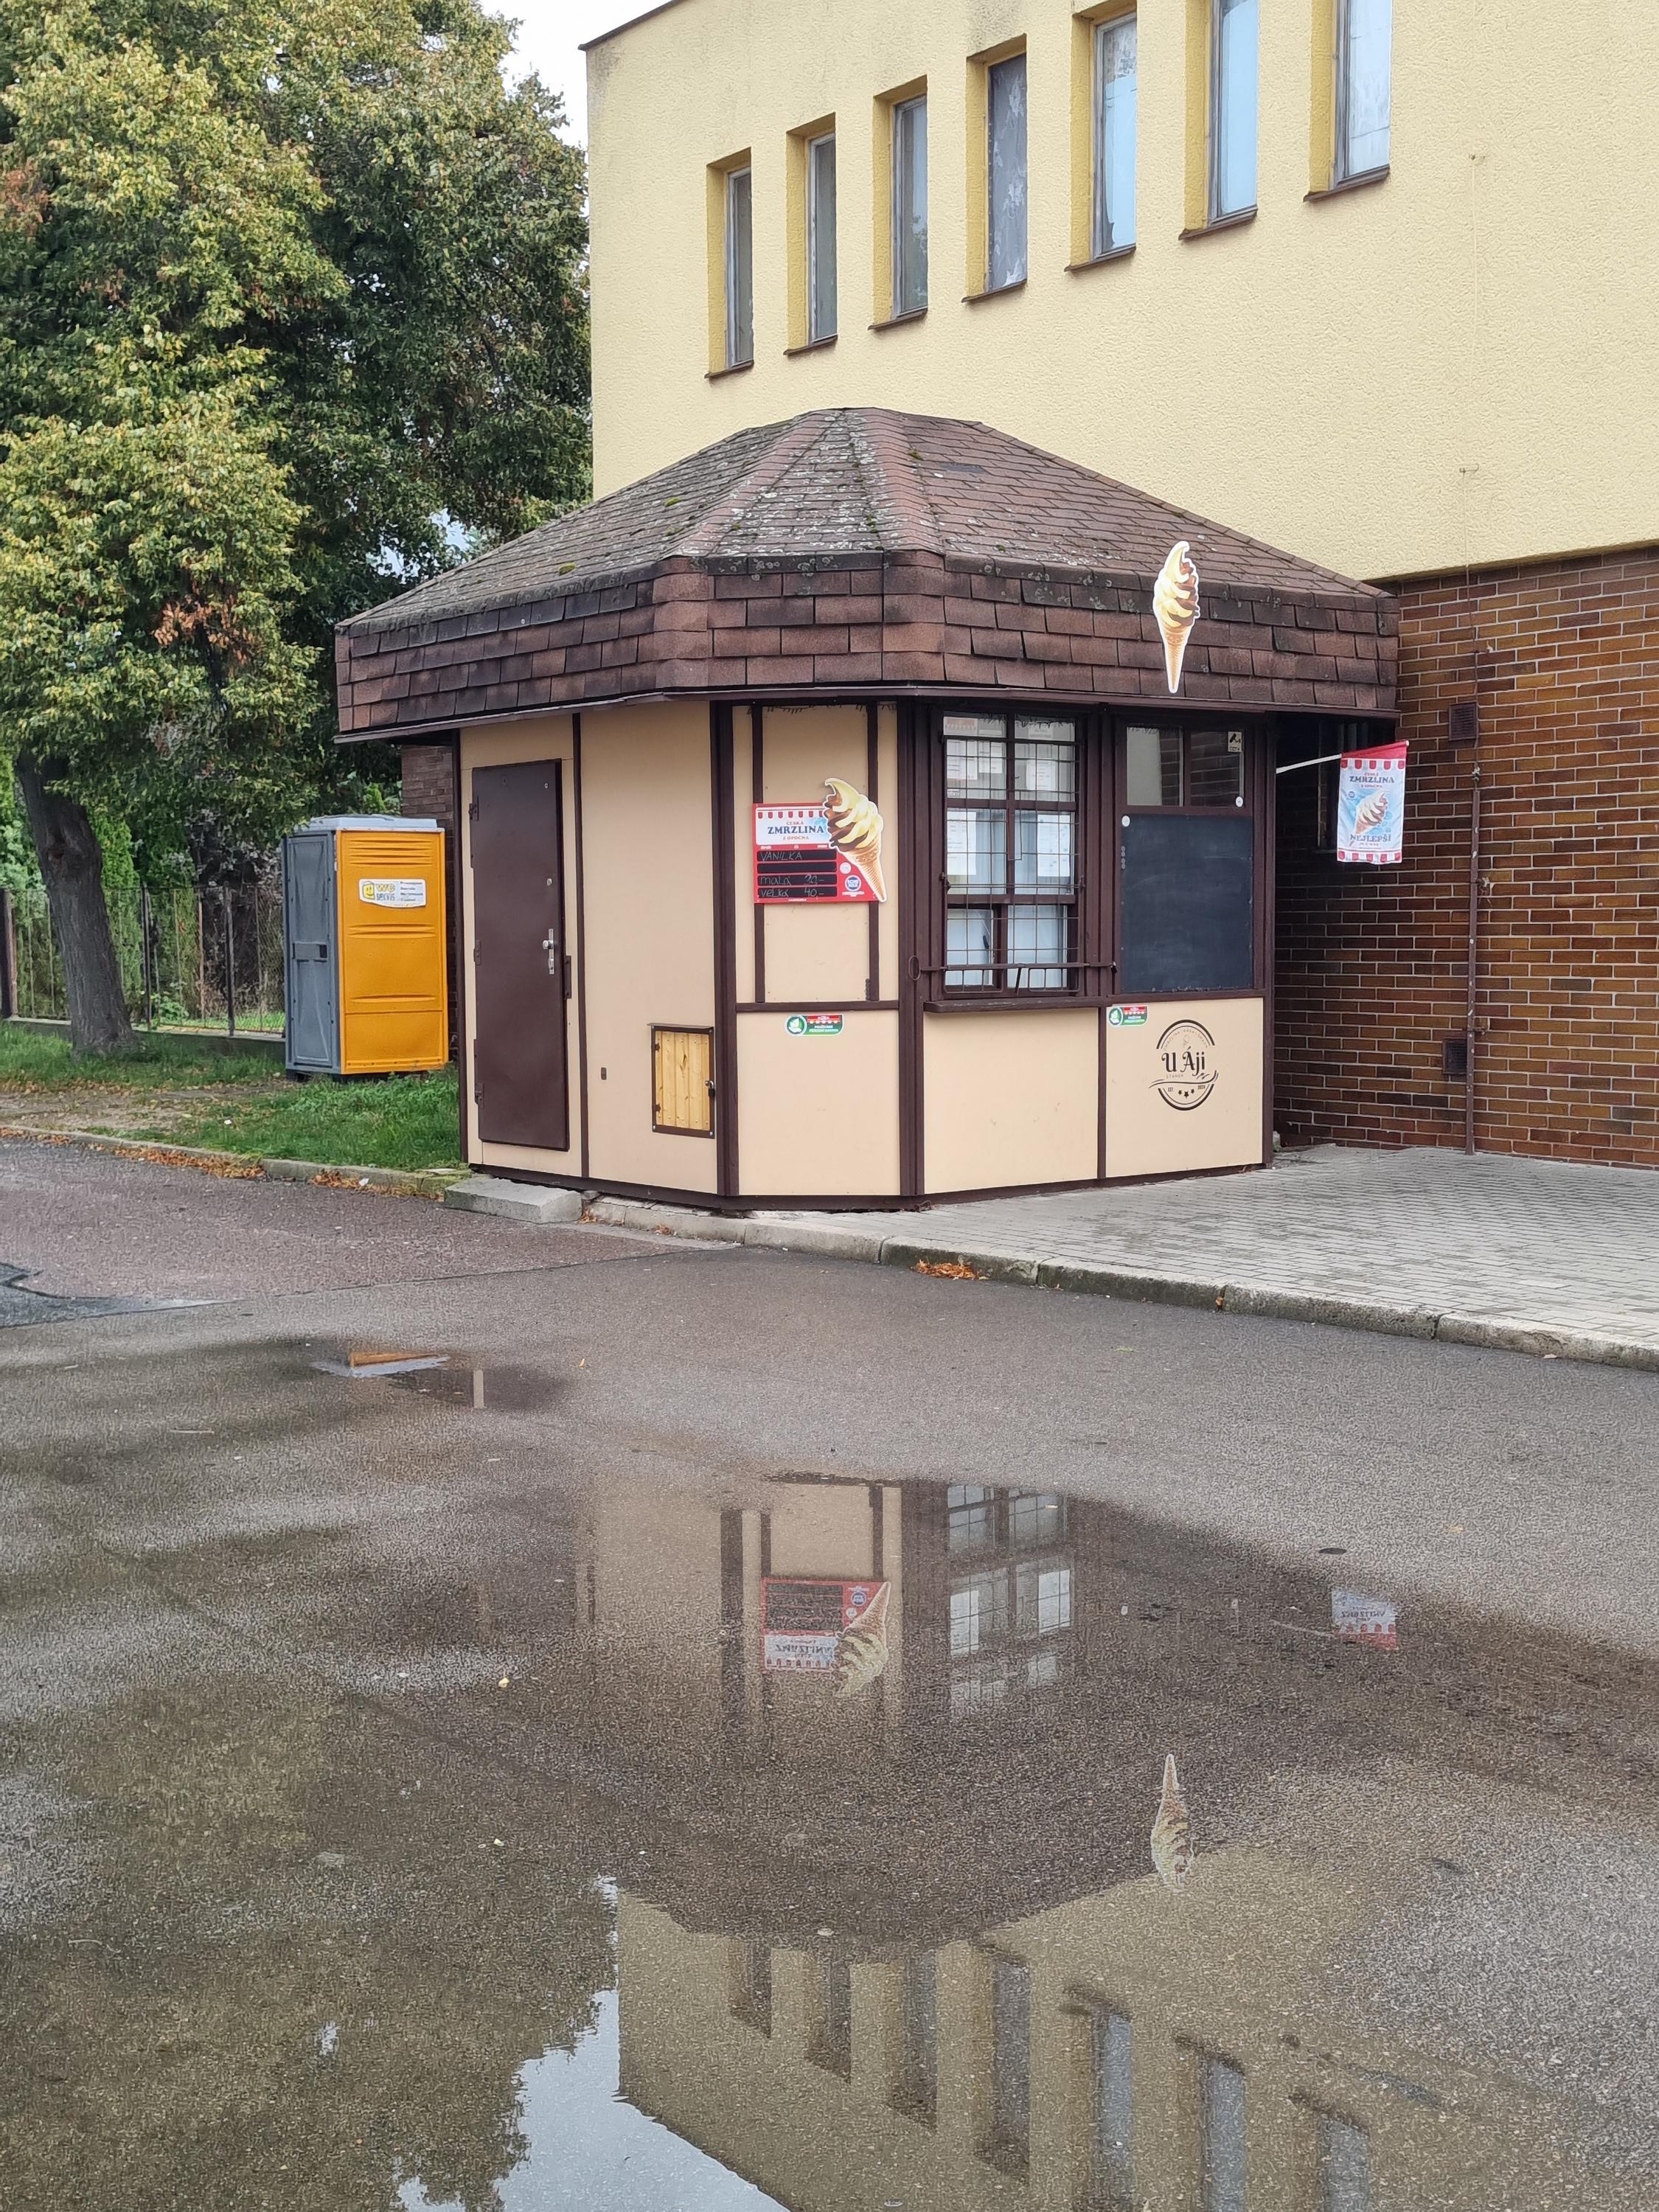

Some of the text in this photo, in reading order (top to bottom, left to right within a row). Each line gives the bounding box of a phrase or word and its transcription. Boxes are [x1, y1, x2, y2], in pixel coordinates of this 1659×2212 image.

[768, 825, 824, 835] ZMRZLINA
[760, 851, 802, 862] VANILKA
[376, 883, 396, 892] WC
[1161, 1046, 1206, 1077] U Áji
